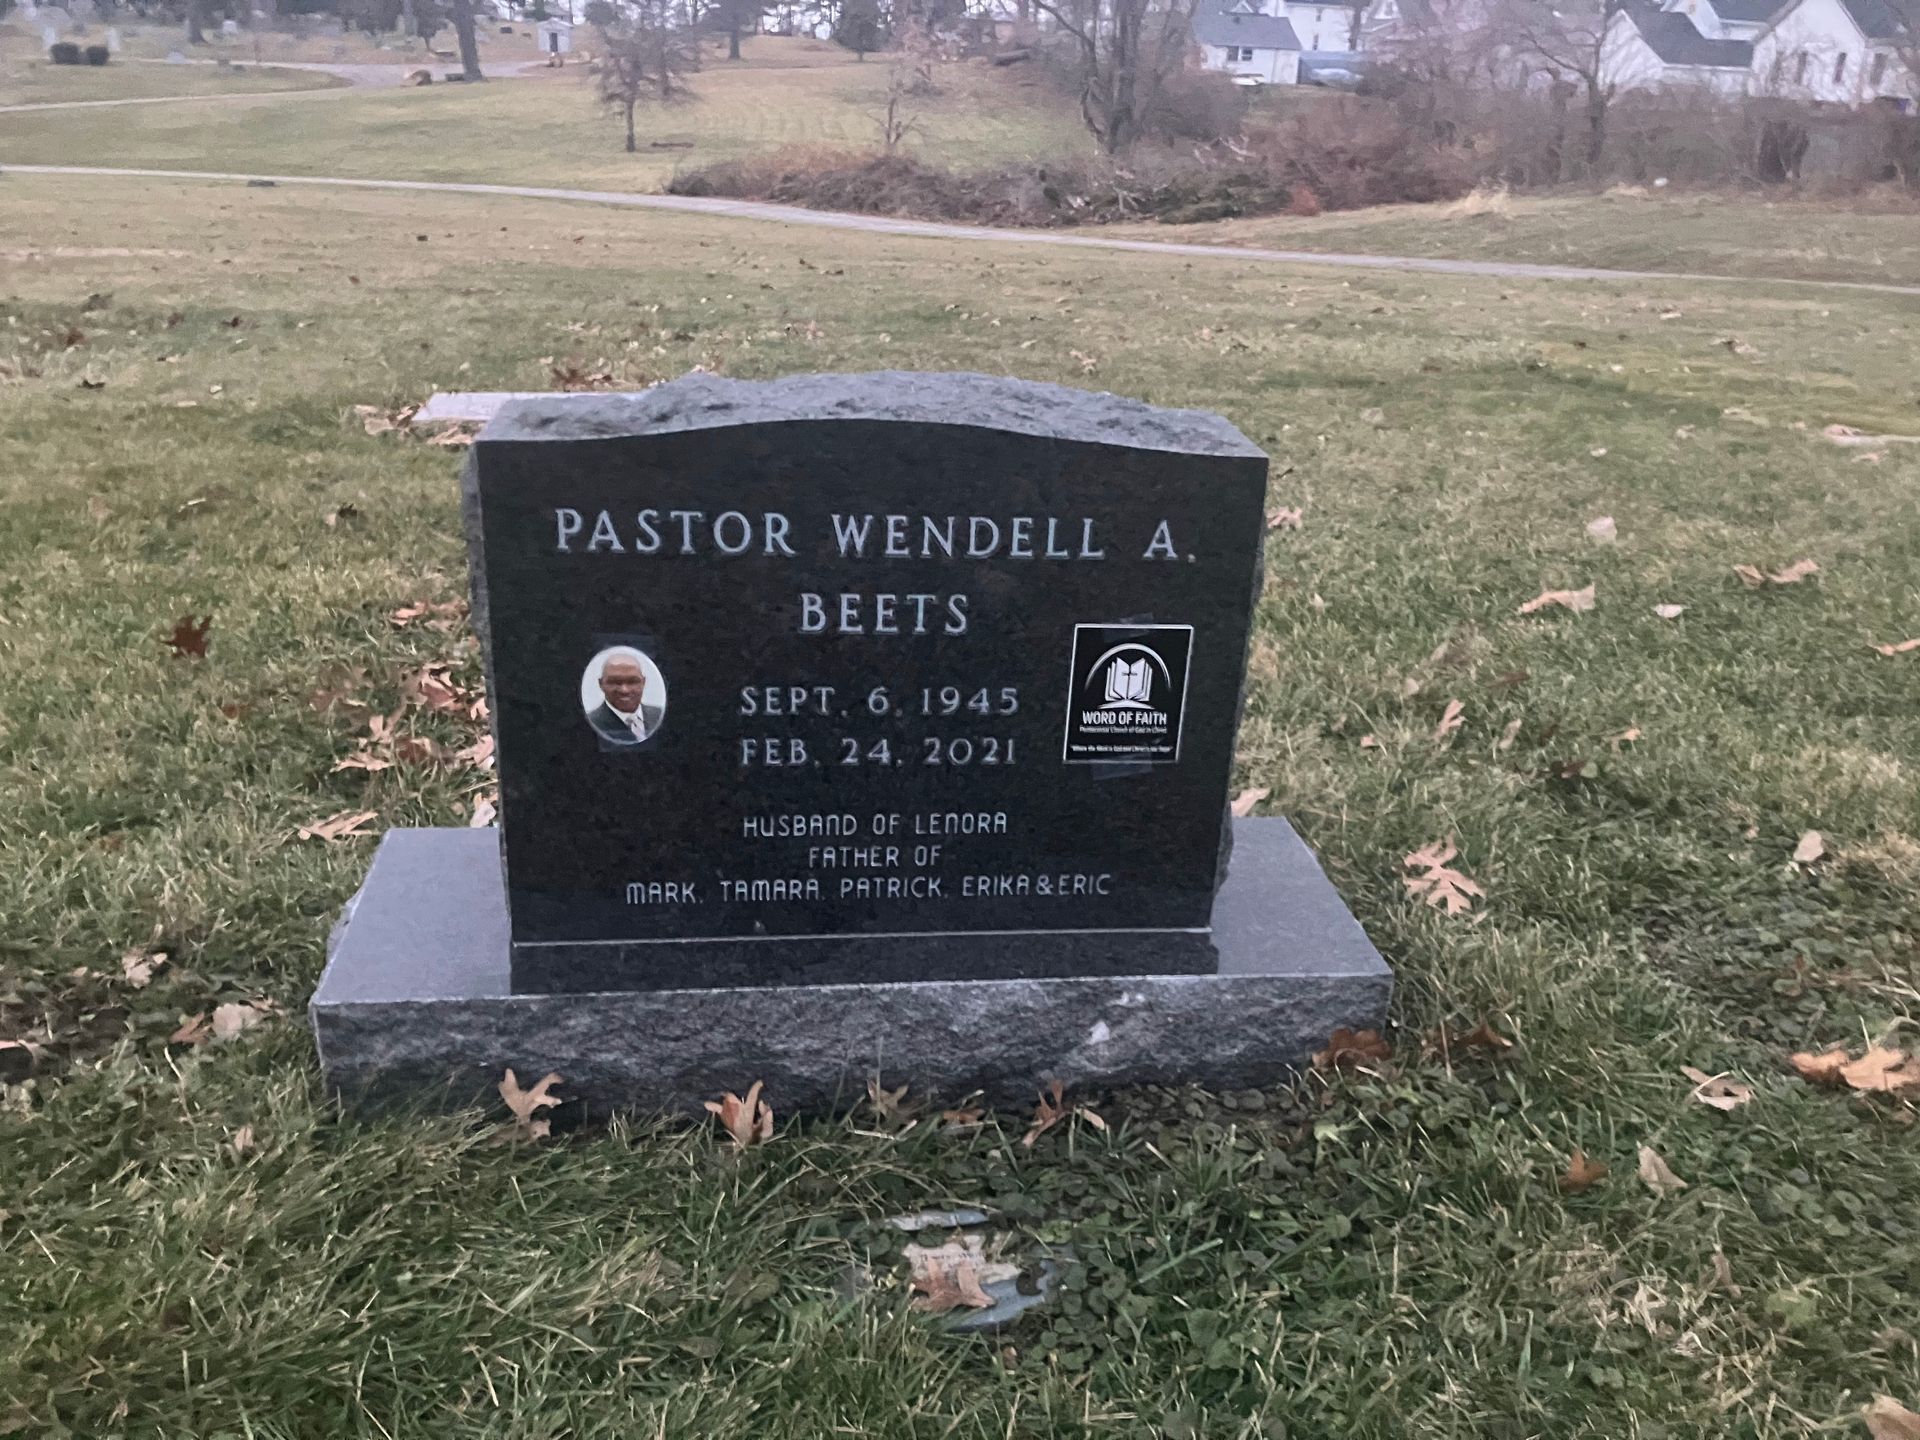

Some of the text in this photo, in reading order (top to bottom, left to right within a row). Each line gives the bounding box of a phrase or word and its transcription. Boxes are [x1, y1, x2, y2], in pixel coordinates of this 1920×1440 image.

[555, 508, 1197, 562] PASTOR WENDELL A.
[800, 593, 968, 635] BEETS
[740, 685, 849, 718] SEPT.
[920, 686, 1019, 716] 1945
[1082, 710, 1168, 725] WORD OF FAITH
[741, 737, 822, 767] FEB.
[923, 736, 1016, 766] 2021
[743, 811, 1008, 838] HUSBAND OF LENORA
[809, 845, 942, 868] FATHER OF
